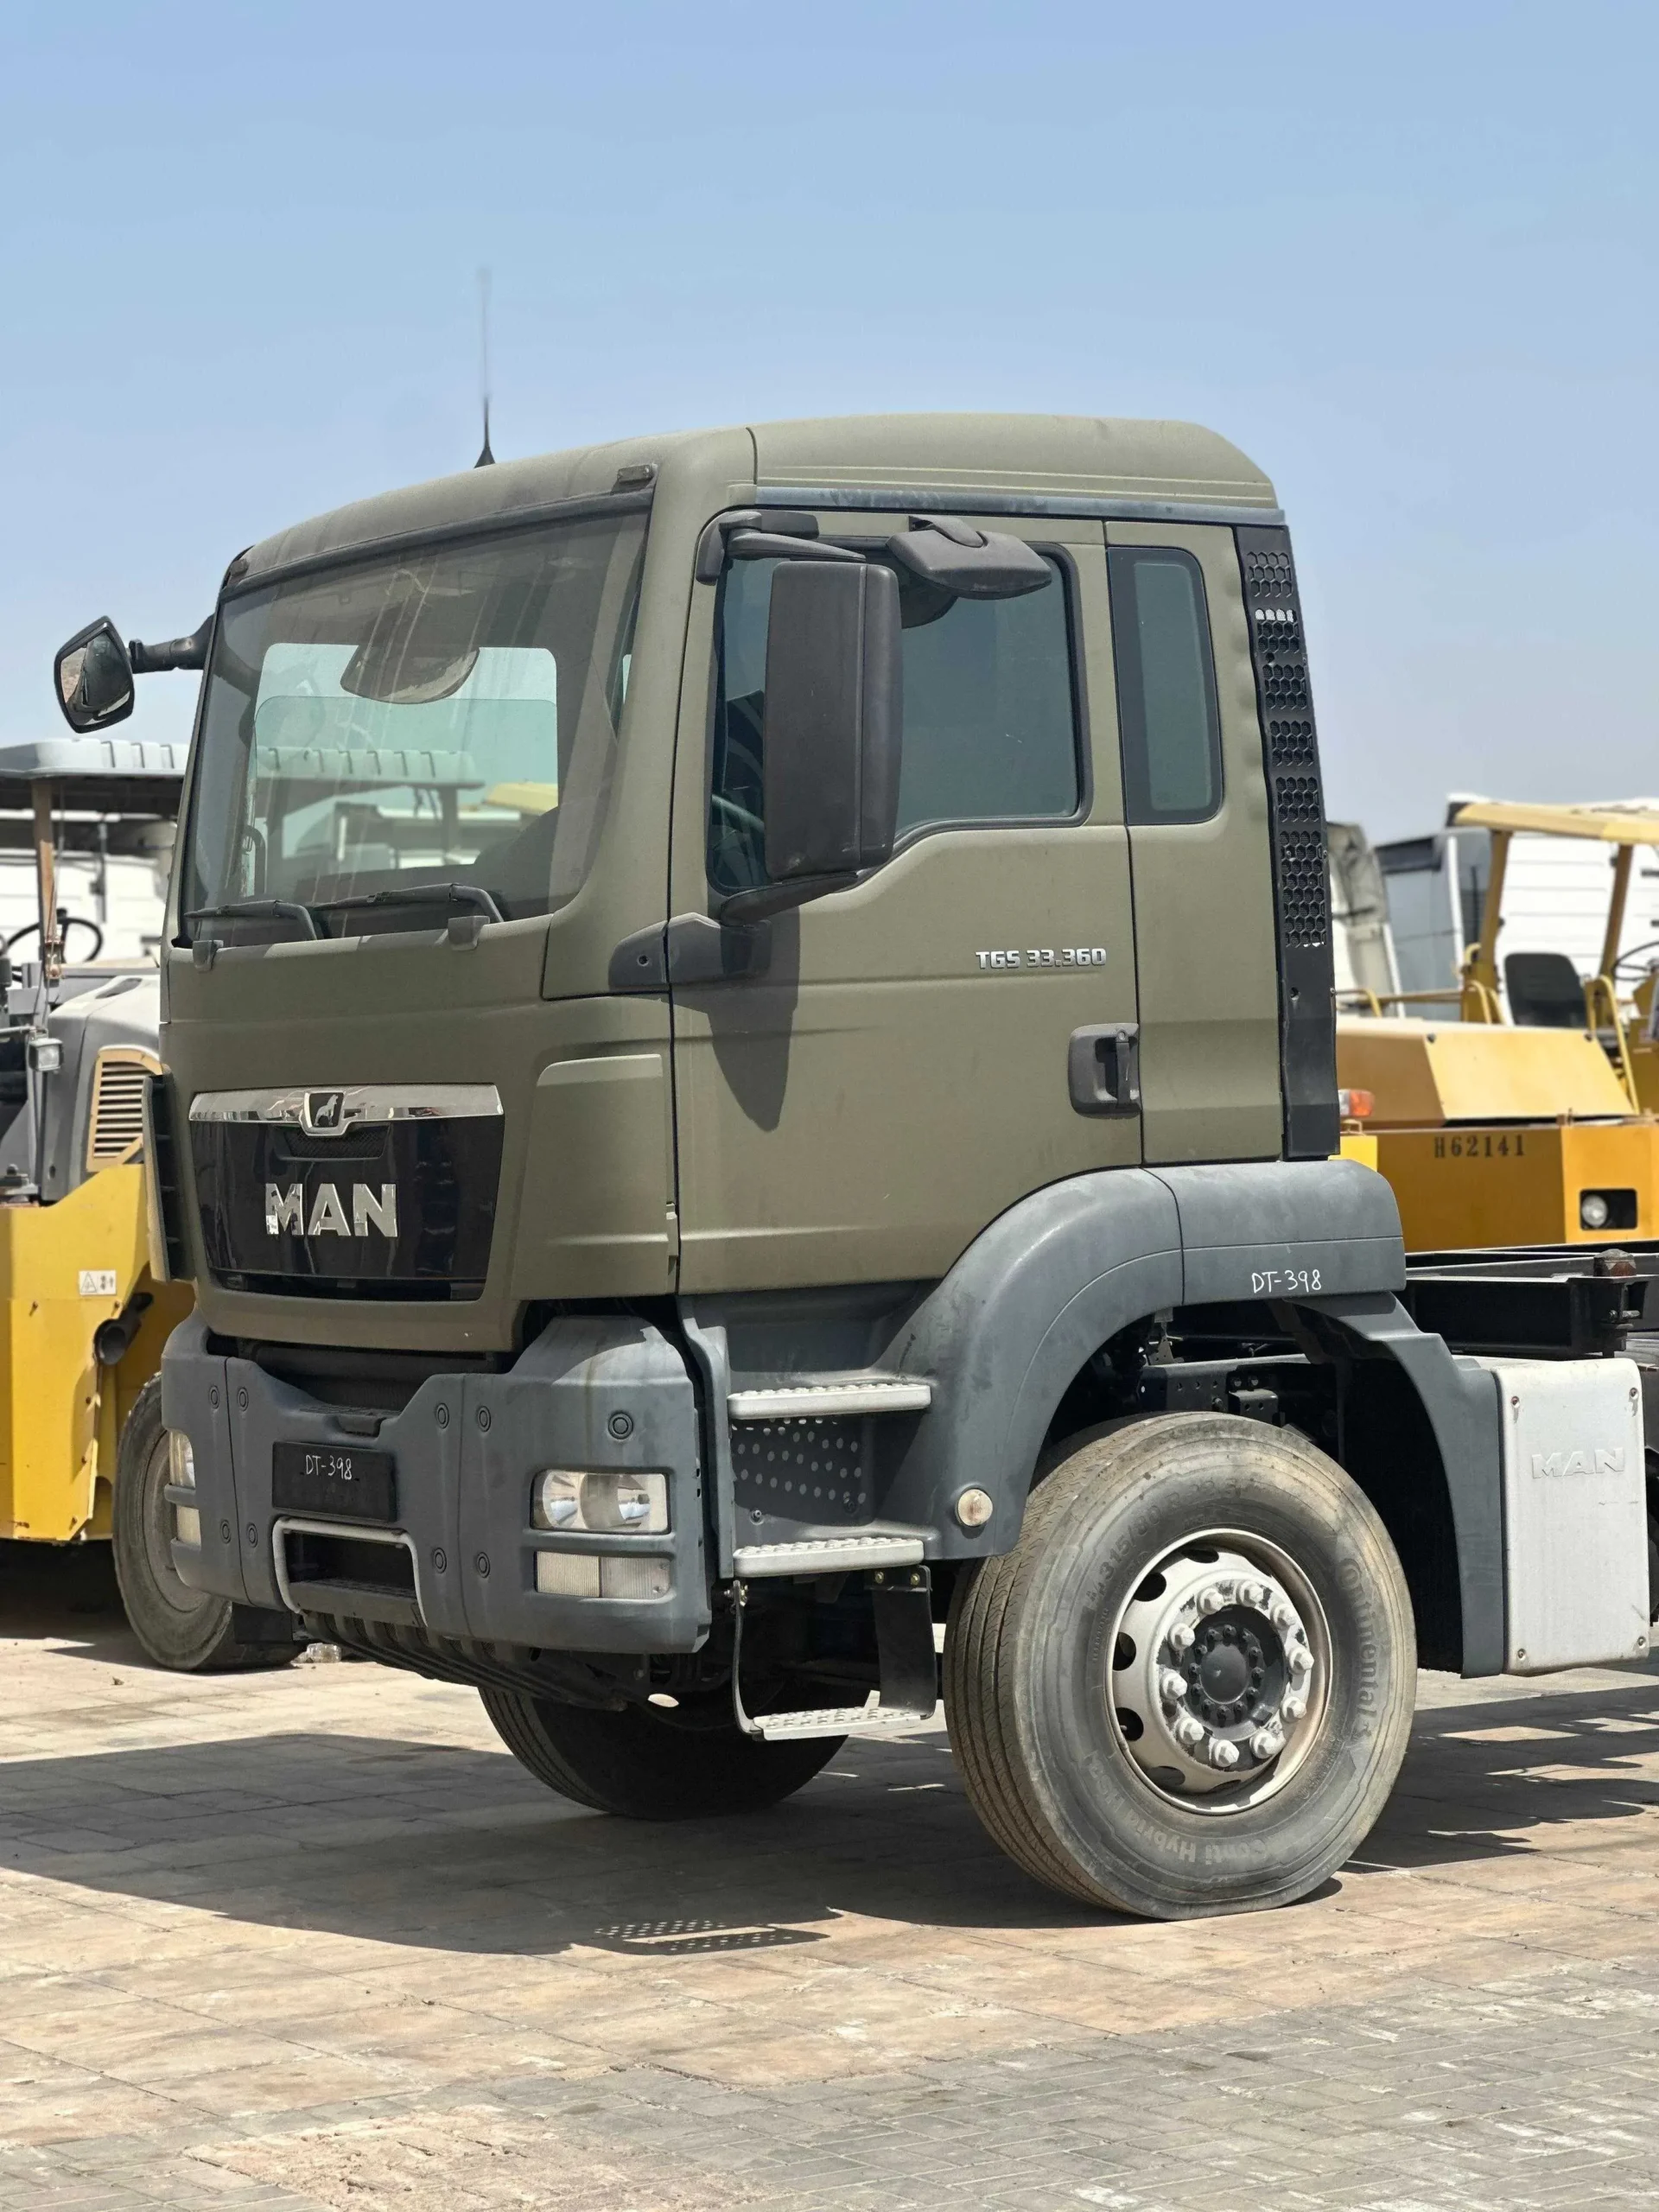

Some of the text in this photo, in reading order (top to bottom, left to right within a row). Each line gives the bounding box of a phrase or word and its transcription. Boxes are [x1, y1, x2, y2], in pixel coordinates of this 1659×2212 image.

[976, 948, 1107, 969] TGS 33.360
[1434, 1134, 1525, 1159] H62141
[265, 1183, 398, 1237] MAN
[1251, 1268, 1322, 1294] DT-398
[305, 1454, 353, 1480] DT-398
[1531, 1447, 1625, 1479] MAN
[1099, 1504, 1160, 1581] 315/80
[1336, 1557, 1380, 1718] Continental
[1124, 1807, 1197, 1864] Hybrid
[1205, 1839, 1268, 1865] Conti
